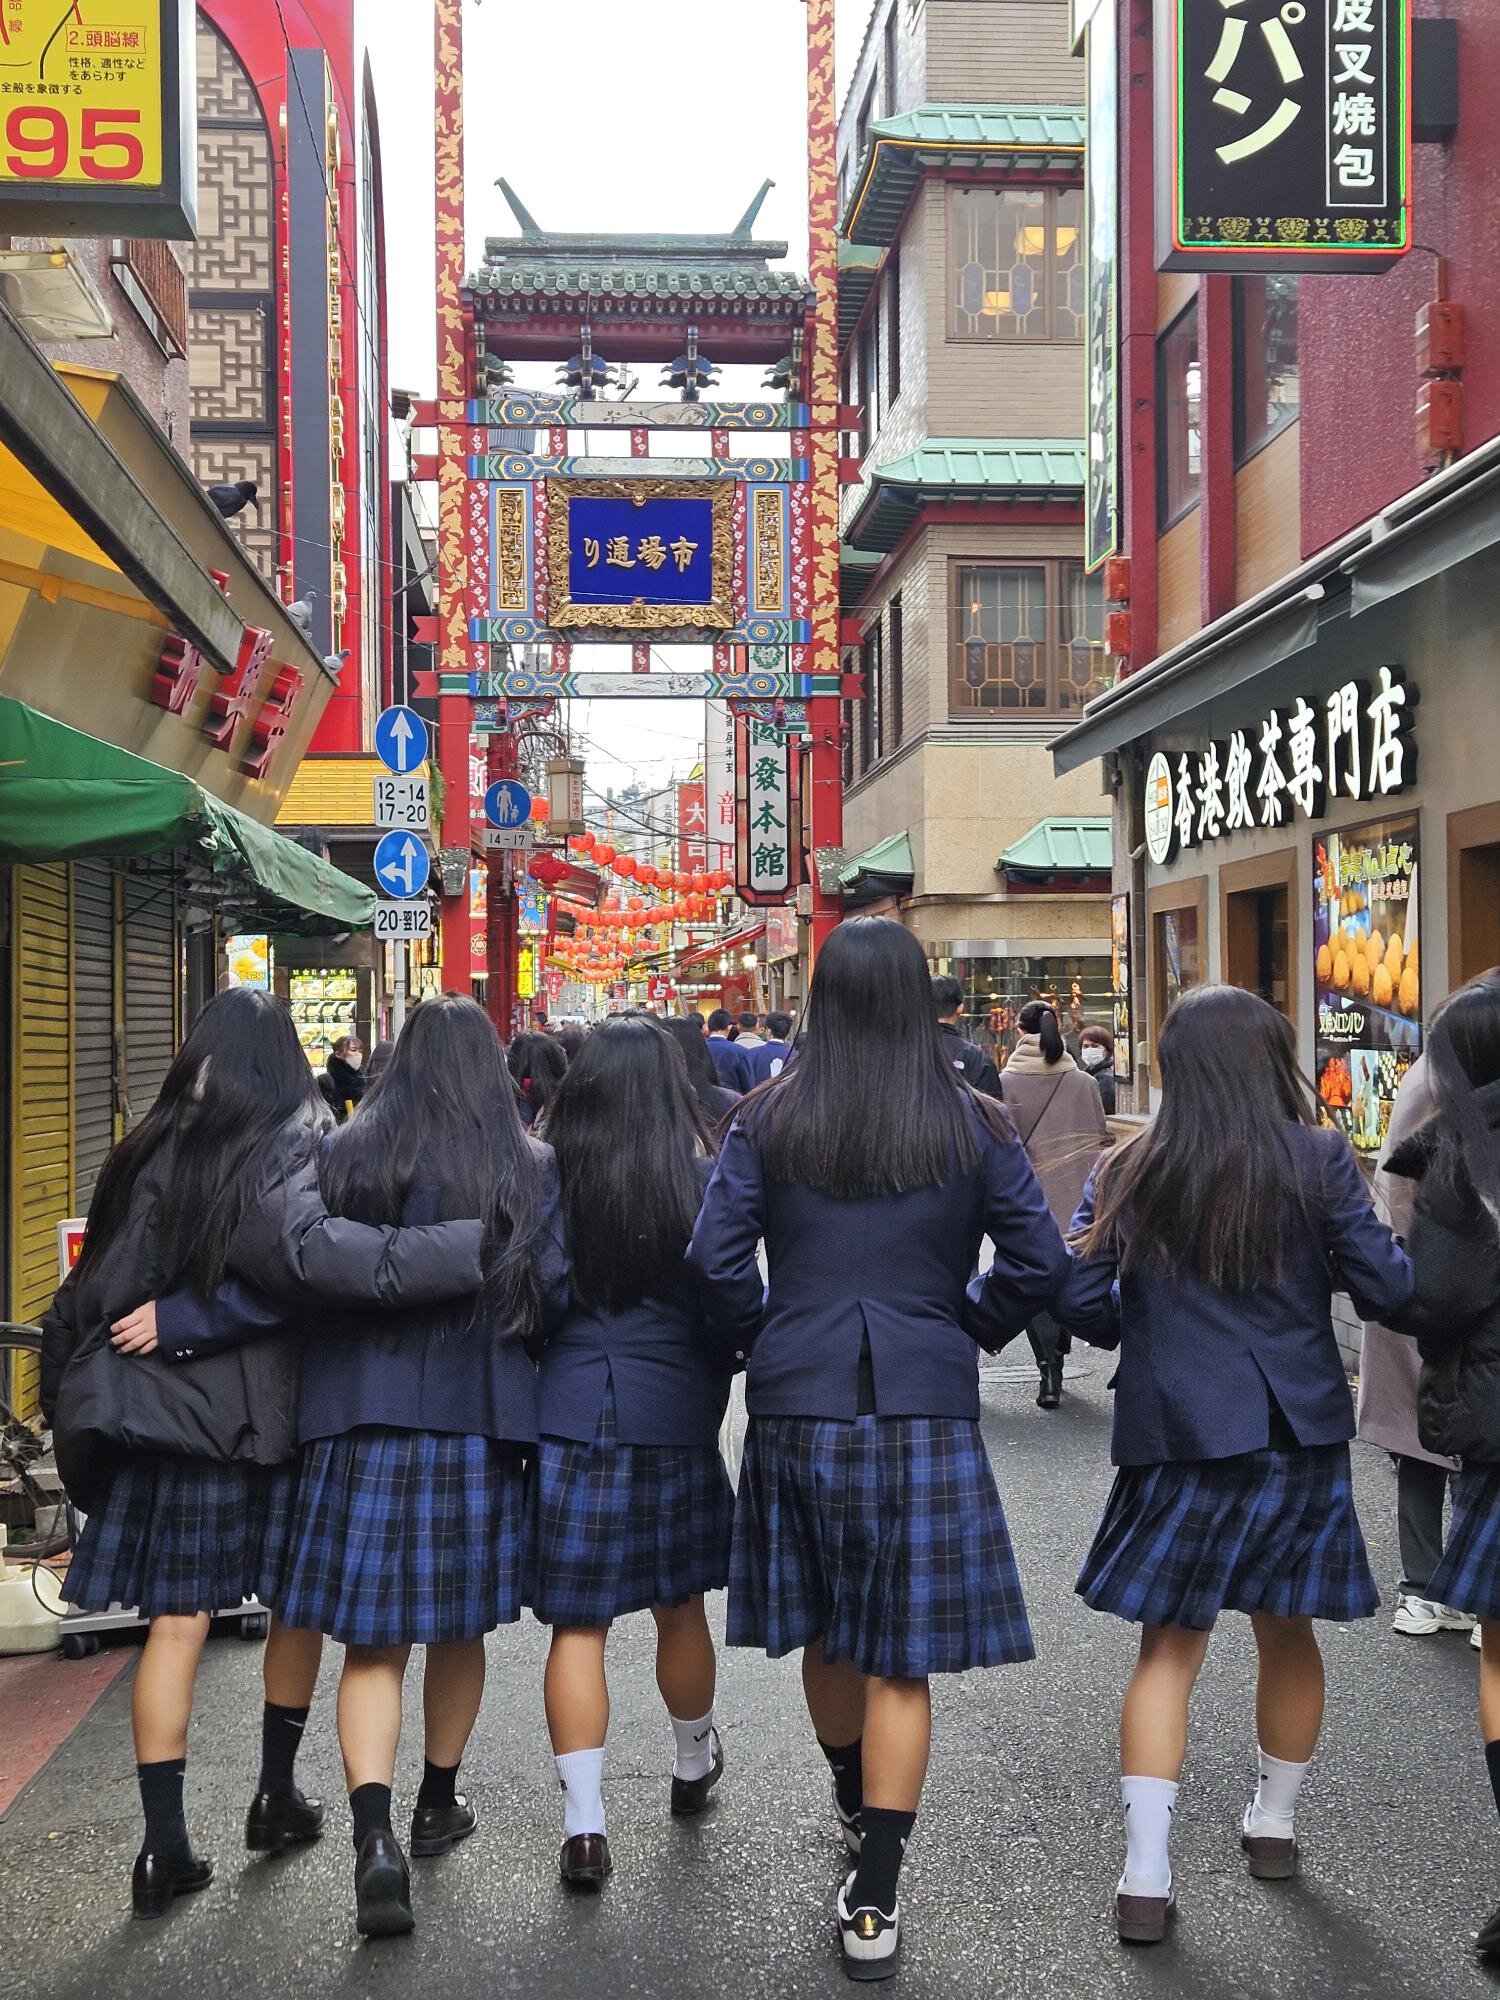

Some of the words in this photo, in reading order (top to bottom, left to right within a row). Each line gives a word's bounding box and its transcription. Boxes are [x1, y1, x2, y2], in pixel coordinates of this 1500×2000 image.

[69, 30, 140, 48] 2.頭脳線
[69, 57, 146, 69] 性格、適性など
[69, 71, 126, 81] をあらわす
[1203, 0, 1307, 165] パン
[5, 105, 145, 181] 95
[378, 782, 426, 801] 12-14
[379, 803, 427, 823] 17-20
[488, 834, 526, 846] 14-17
